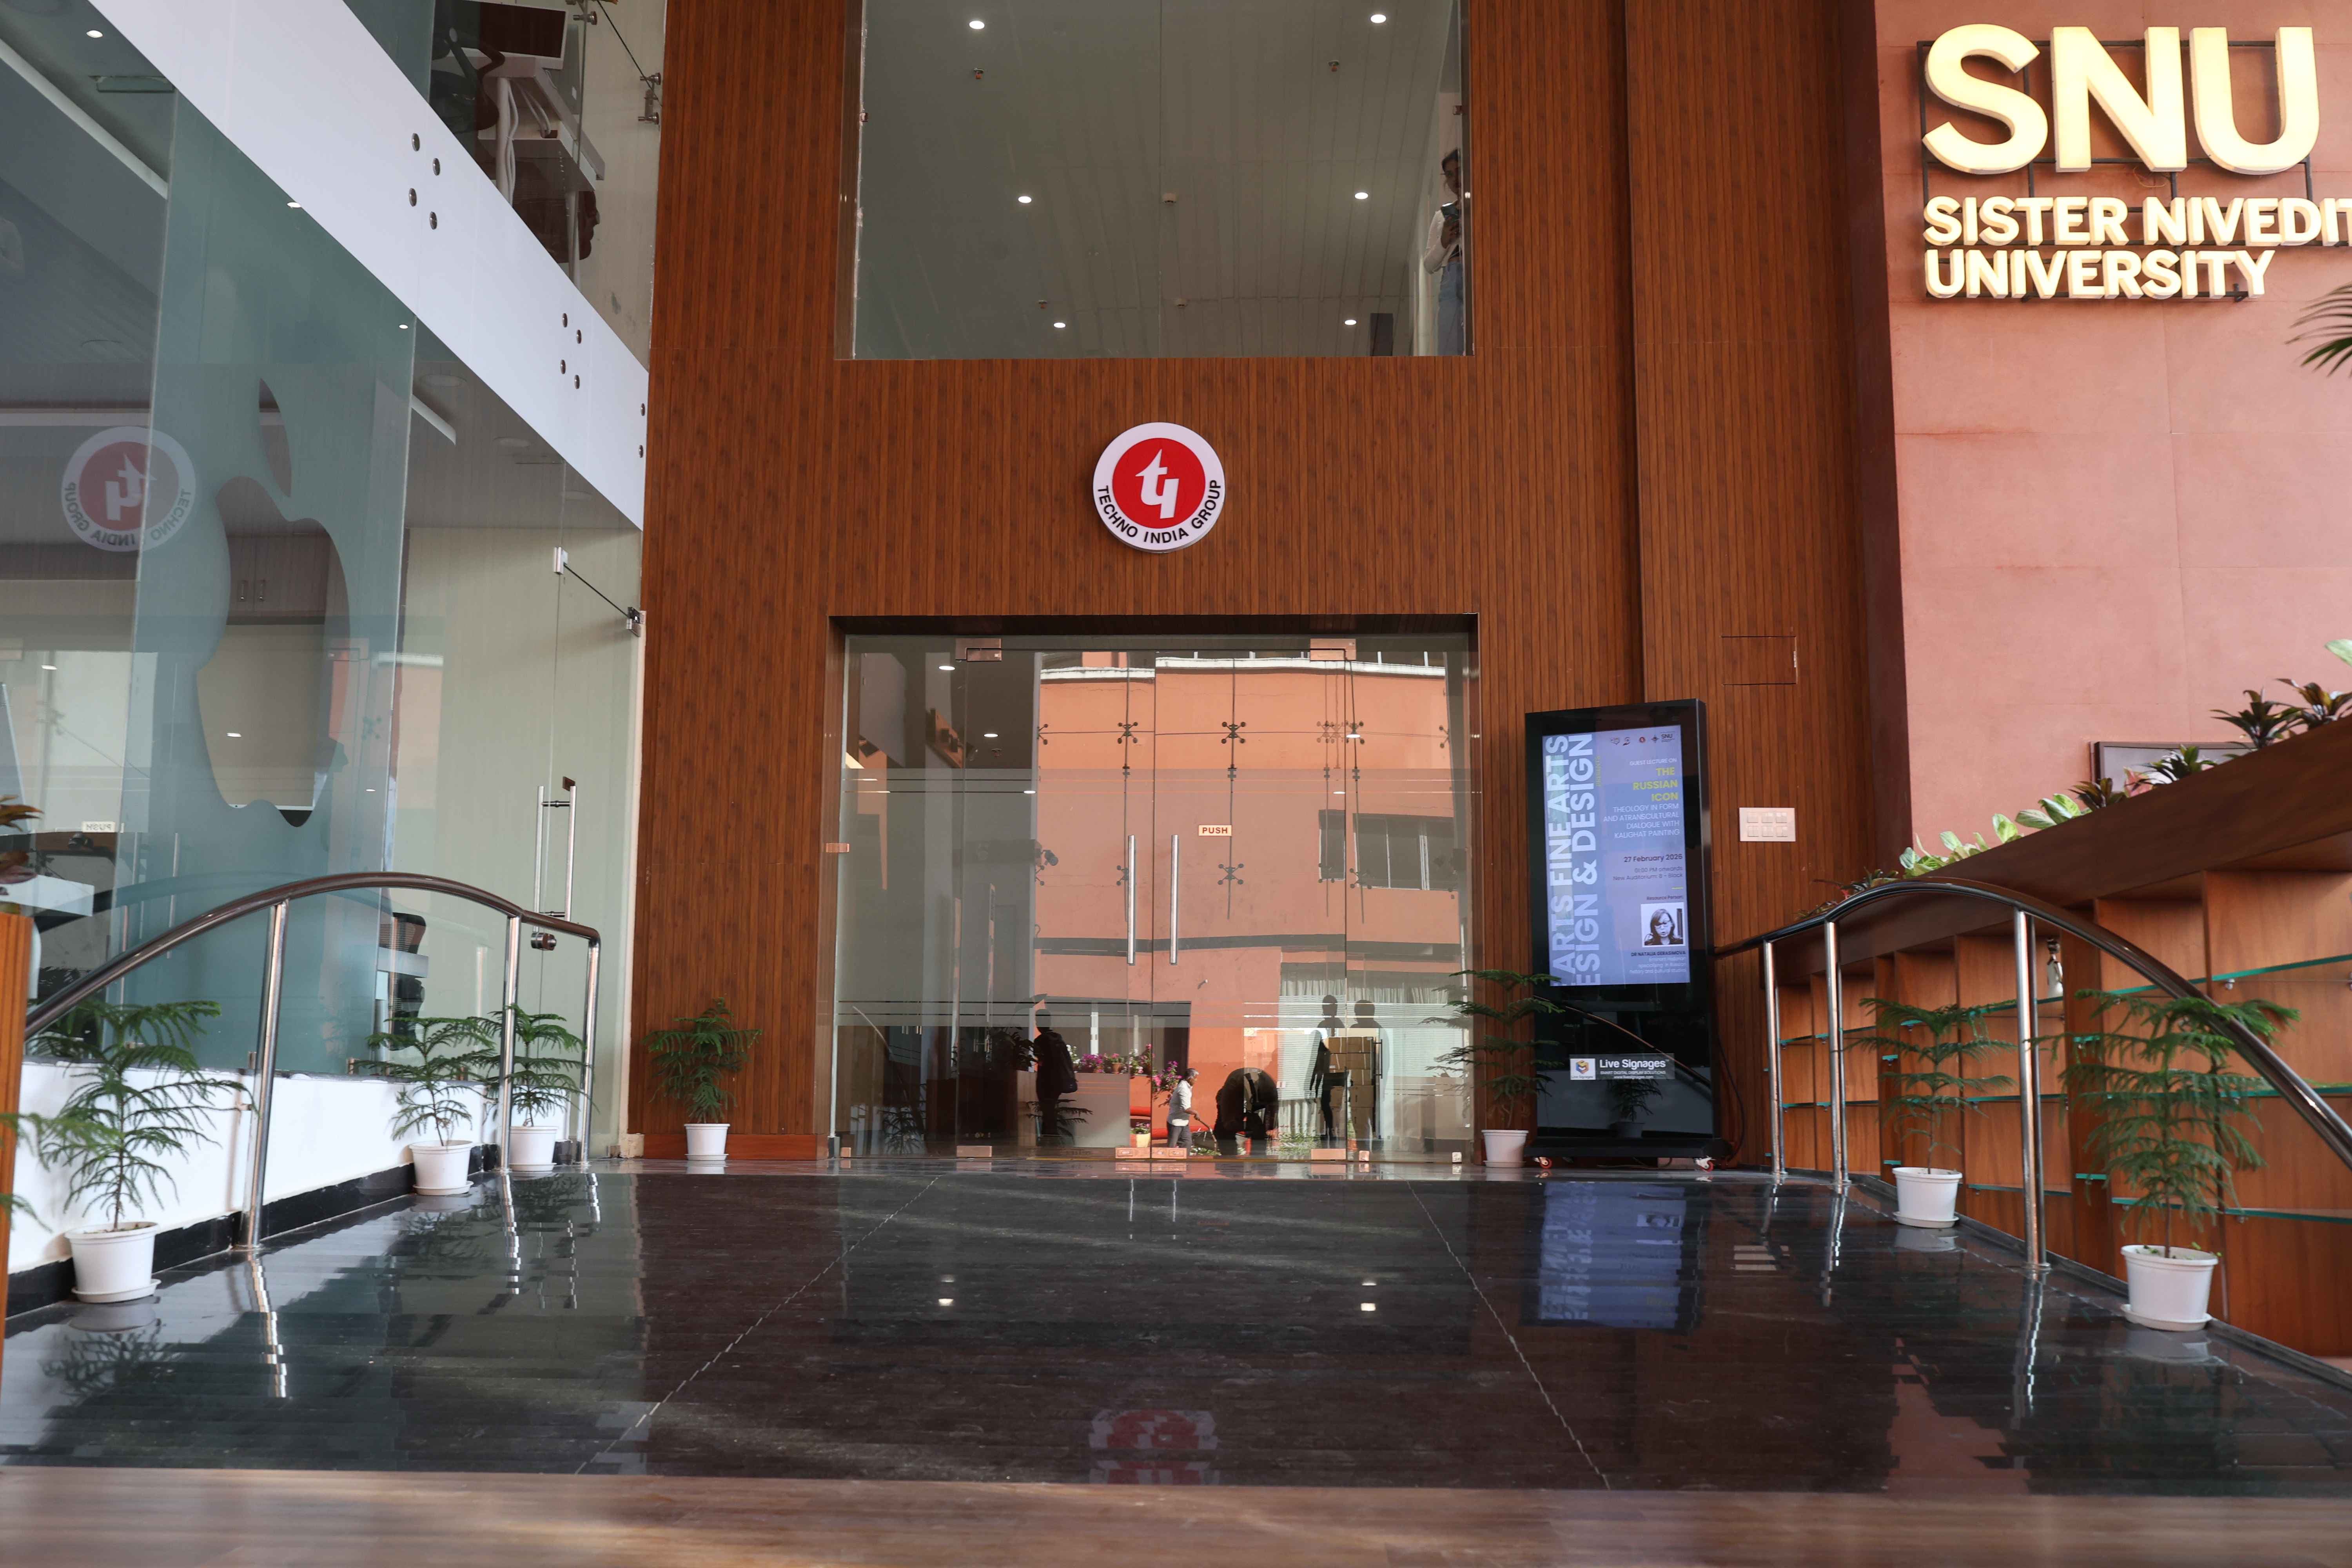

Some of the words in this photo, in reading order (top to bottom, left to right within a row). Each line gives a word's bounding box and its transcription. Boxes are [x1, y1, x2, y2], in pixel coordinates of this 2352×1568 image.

[1922, 23, 2319, 175] SNU
[1923, 196, 2128, 246] SISTER
[1925, 249, 2275, 299] UNIVERSITY
[1098, 485, 1138, 537] TECHNO
[1143, 528, 1189, 543] INDIA
[1191, 480, 1221, 529] GROUP
[1545, 736, 1570, 814] ARTS
[1568, 734, 1596, 852] DESIGN
[1633, 779, 1678, 790] RUSSIAN
[1651, 792, 1679, 801] ICON
[1656, 767, 1675, 776] THE
[1549, 822, 1573, 886] FINE
[1572, 859, 1597, 884] &
[1551, 895, 1576, 974] ARTS
[1599, 1059, 1620, 1068] Live
[1622, 1059, 1666, 1070] Signages
